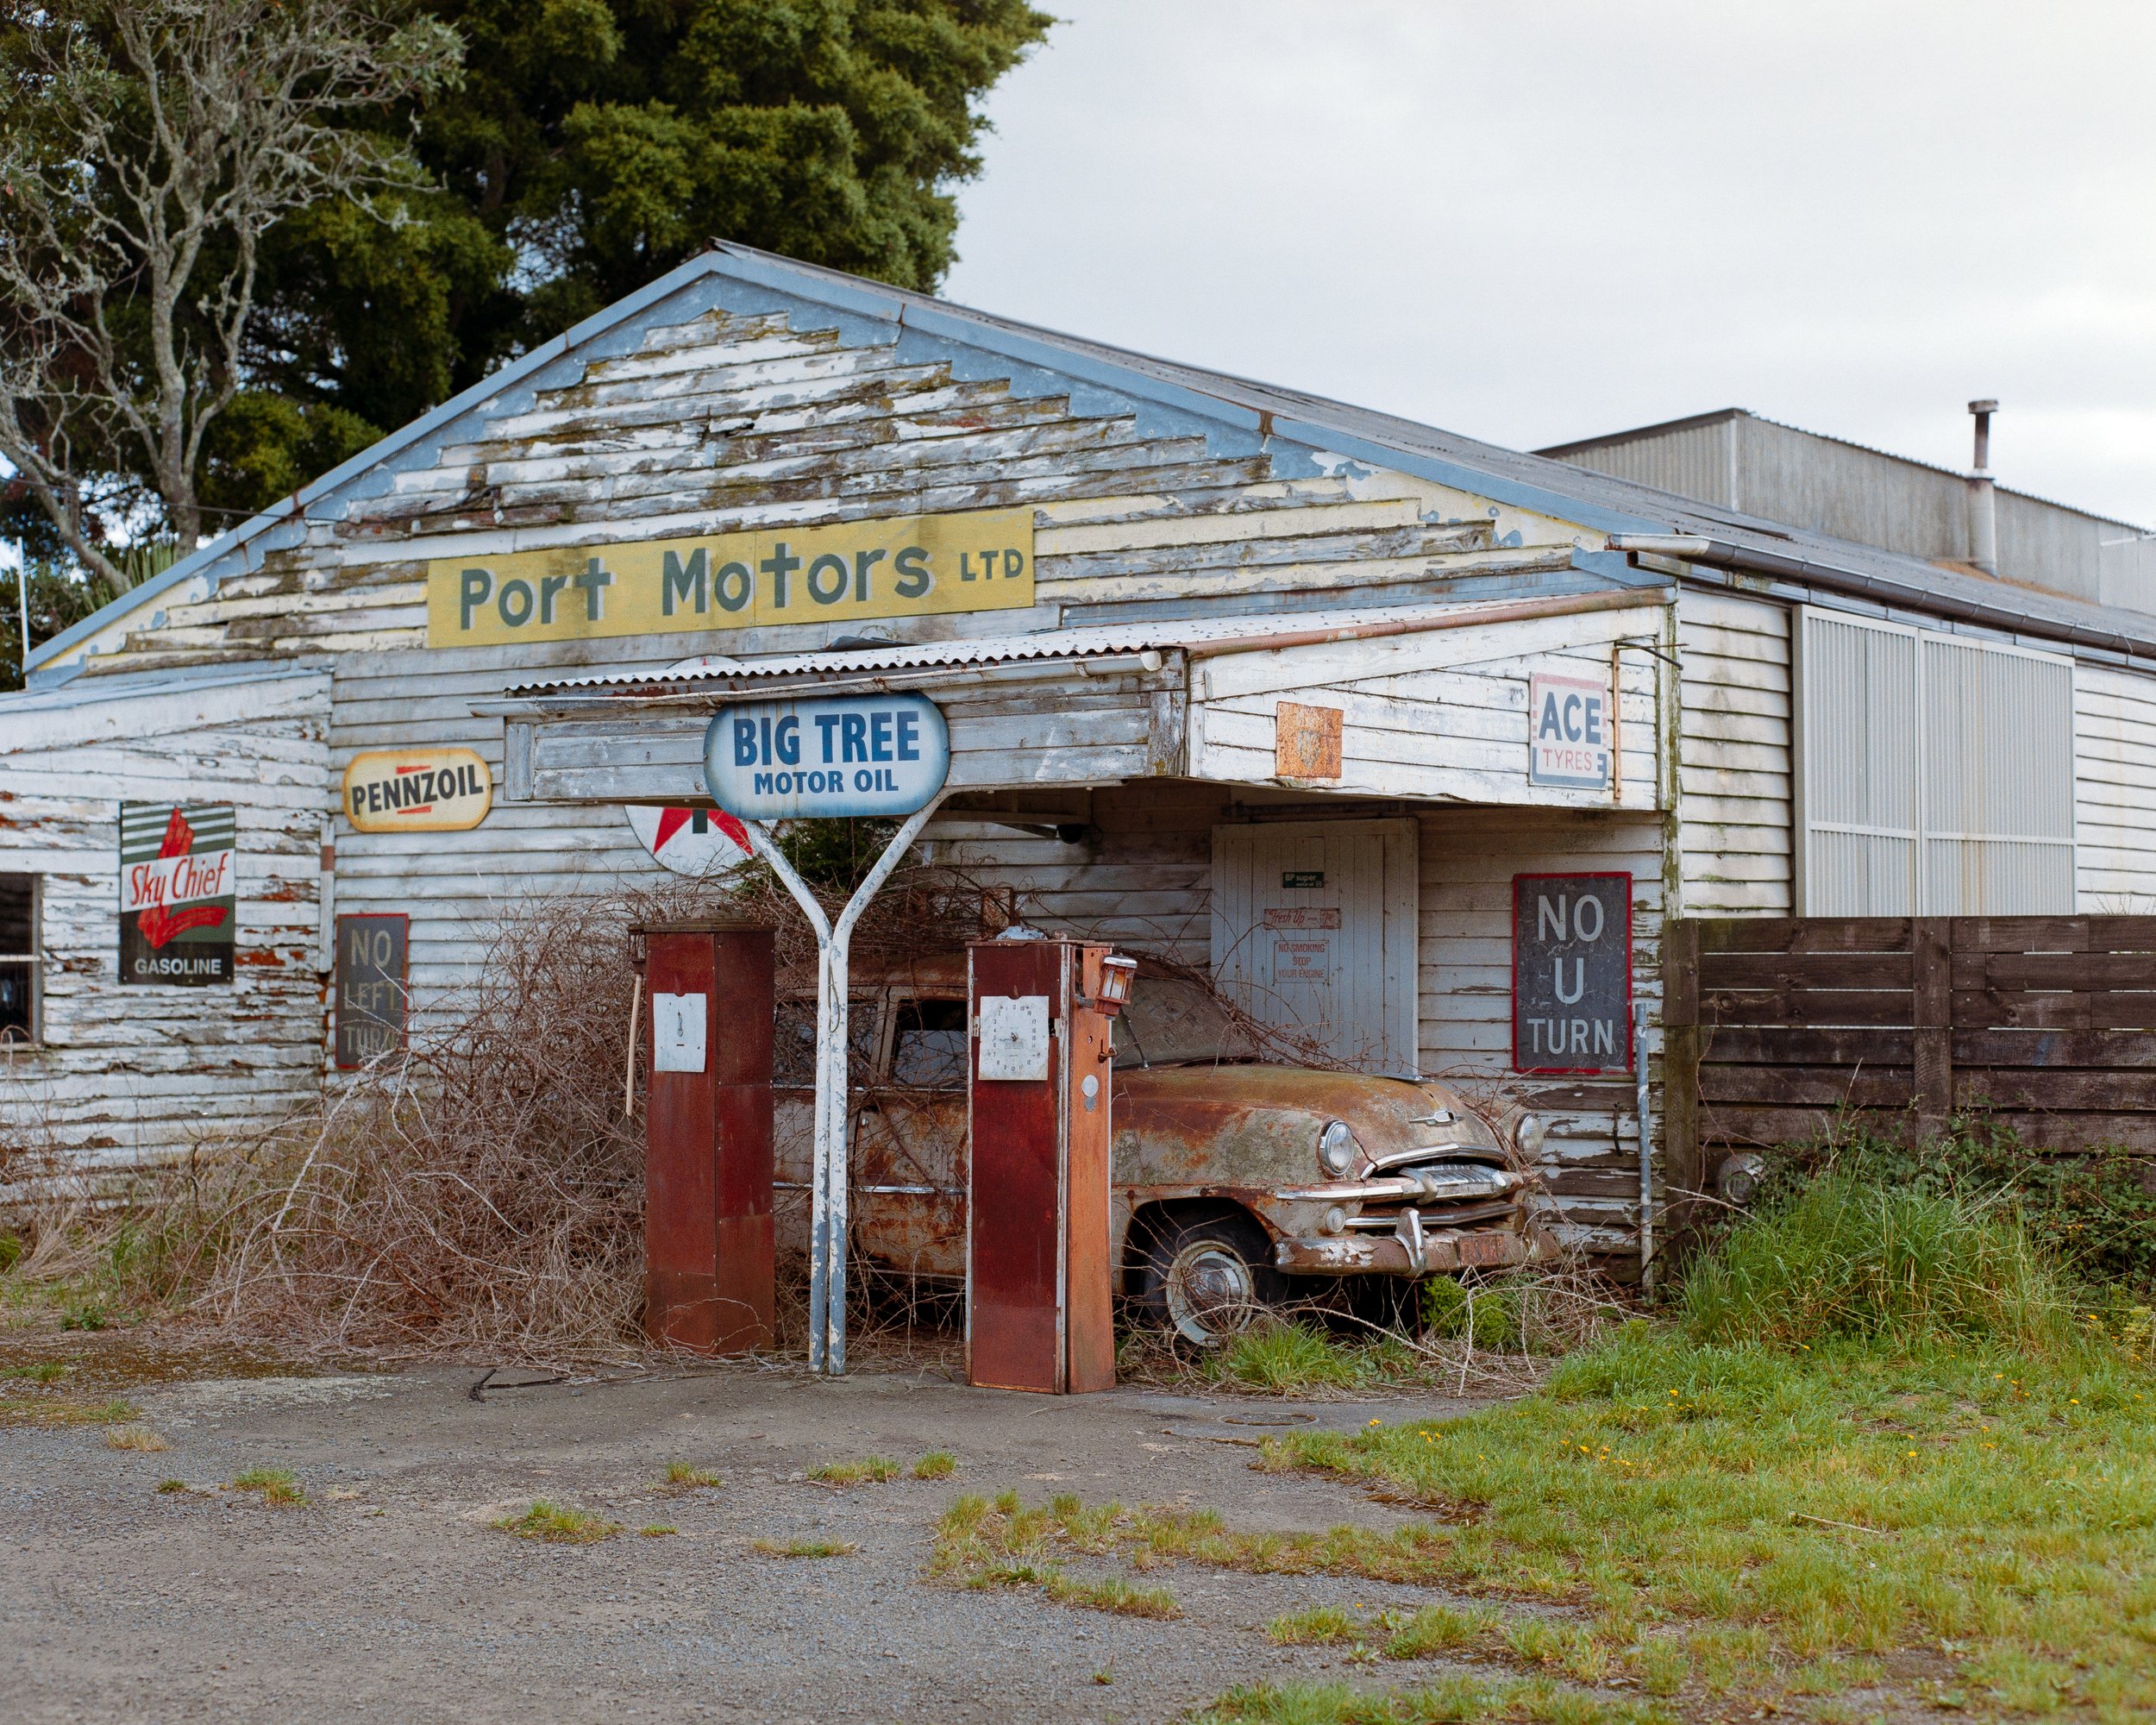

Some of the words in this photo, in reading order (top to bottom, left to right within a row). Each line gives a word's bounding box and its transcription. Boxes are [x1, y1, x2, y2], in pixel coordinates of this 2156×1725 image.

[460, 557, 616, 630] Port
[661, 543, 934, 617] Motors
[960, 548, 1025, 582] LTD
[1538, 691, 1601, 745] ACE
[733, 715, 800, 767] BIG
[814, 711, 920, 763] TREE
[1542, 748, 1593, 772] TYRES
[351, 763, 485, 816] PENNZOIL
[754, 770, 845, 795] MOTOR
[853, 768, 899, 793] OIL
[130, 863, 167, 906] Sky
[172, 852, 229, 900] Chief
[1538, 894, 1604, 942] NO
[134, 957, 222, 975] GASOLINE
[350, 929, 392, 968] NO
[1278, 944, 1289, 953] NO
[1290, 943, 1326, 953] SMOKING
[1292, 956, 1311, 966] STOP
[1277, 969, 1297, 978] YOUR
[1299, 969, 1325, 978] ENGINE
[1555, 957, 1584, 1005] U
[344, 982, 398, 1010] LEFT
[1526, 1018, 1614, 1055] TURN
